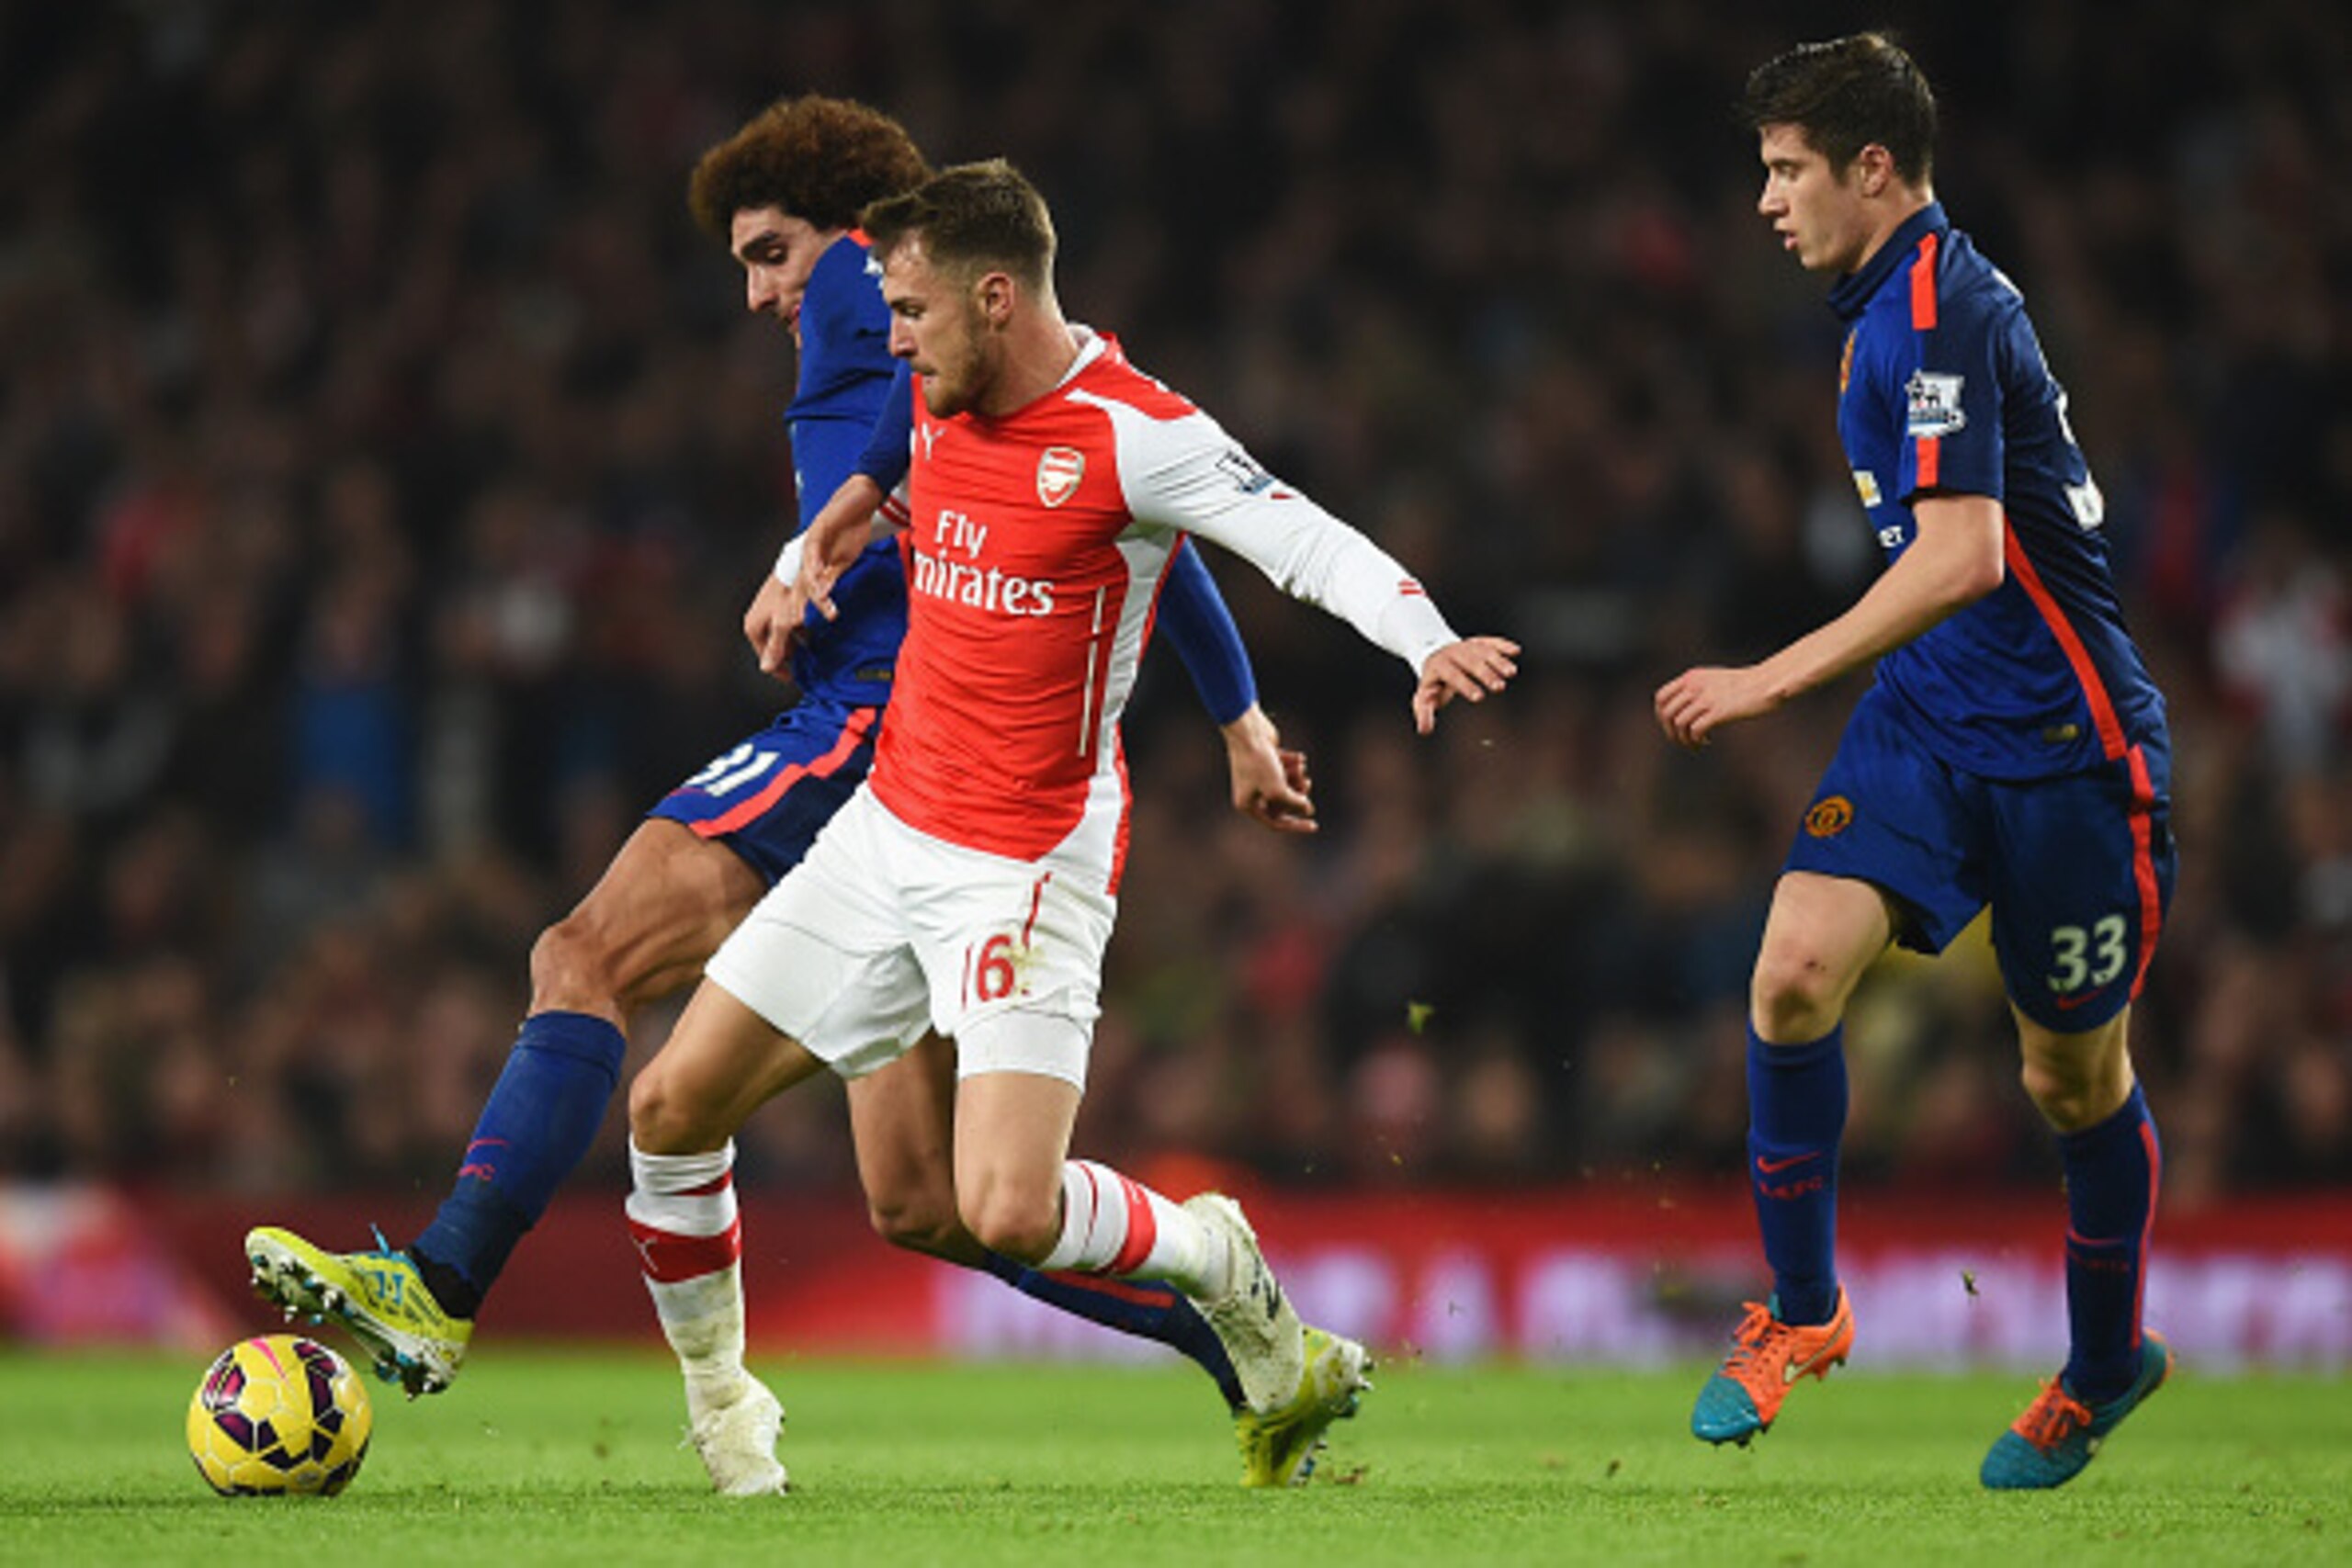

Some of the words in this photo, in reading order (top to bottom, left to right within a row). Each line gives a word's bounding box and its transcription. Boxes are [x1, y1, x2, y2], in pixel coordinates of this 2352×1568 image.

[934, 510, 988, 558] Fly
[914, 547, 1054, 616] mirates
[2047, 915, 2126, 992] 33
